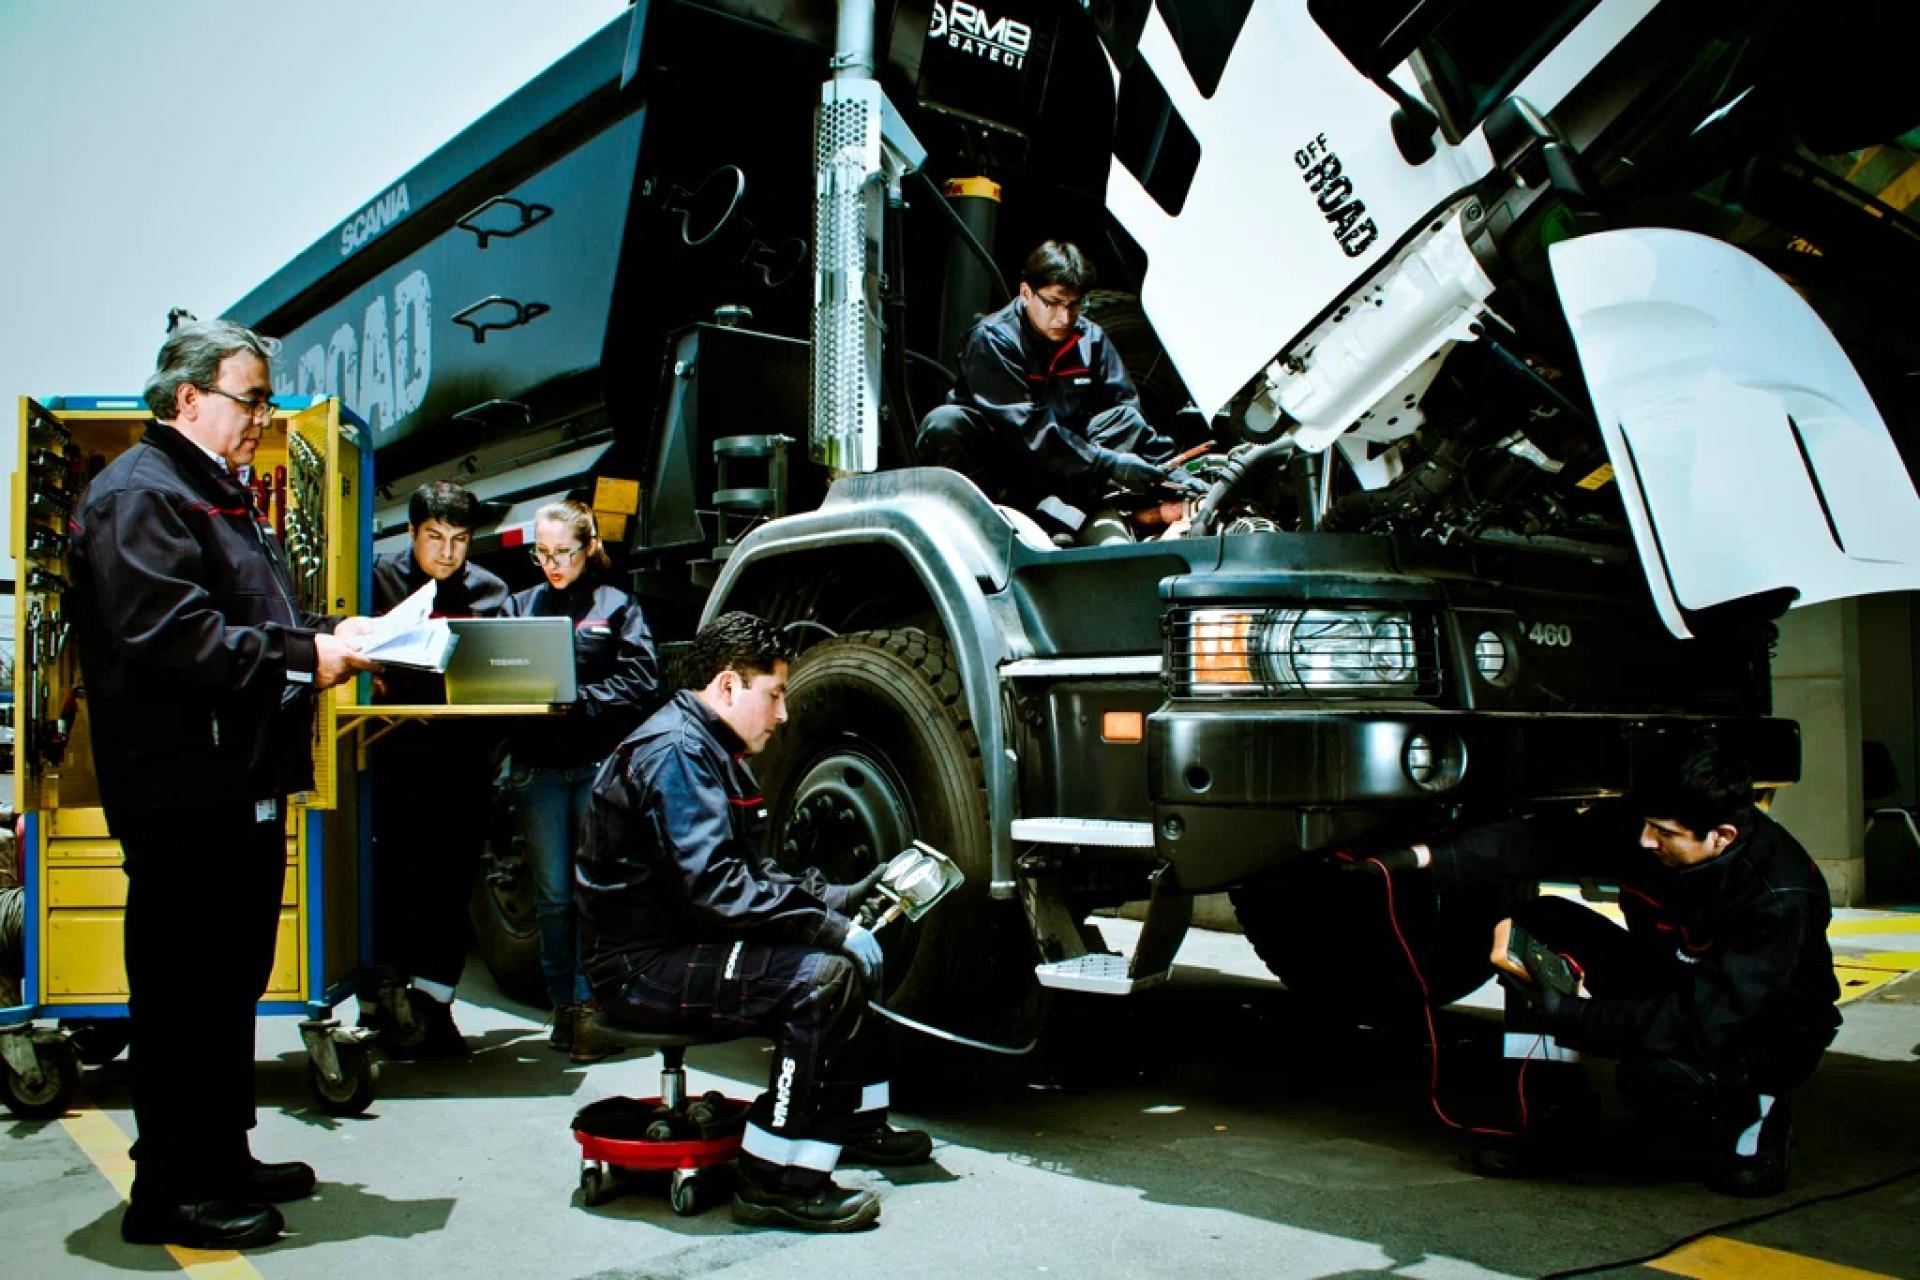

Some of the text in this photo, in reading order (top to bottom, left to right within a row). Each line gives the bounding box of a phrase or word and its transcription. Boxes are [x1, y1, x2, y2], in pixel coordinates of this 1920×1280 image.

[949, 0, 1032, 53] RMB
[1294, 132, 1328, 170] OFF
[340, 181, 410, 256] SCANIA
[1303, 151, 1378, 258] ROAD
[1528, 622, 1572, 648] 460
[772, 1056, 796, 1128] SCANIA
